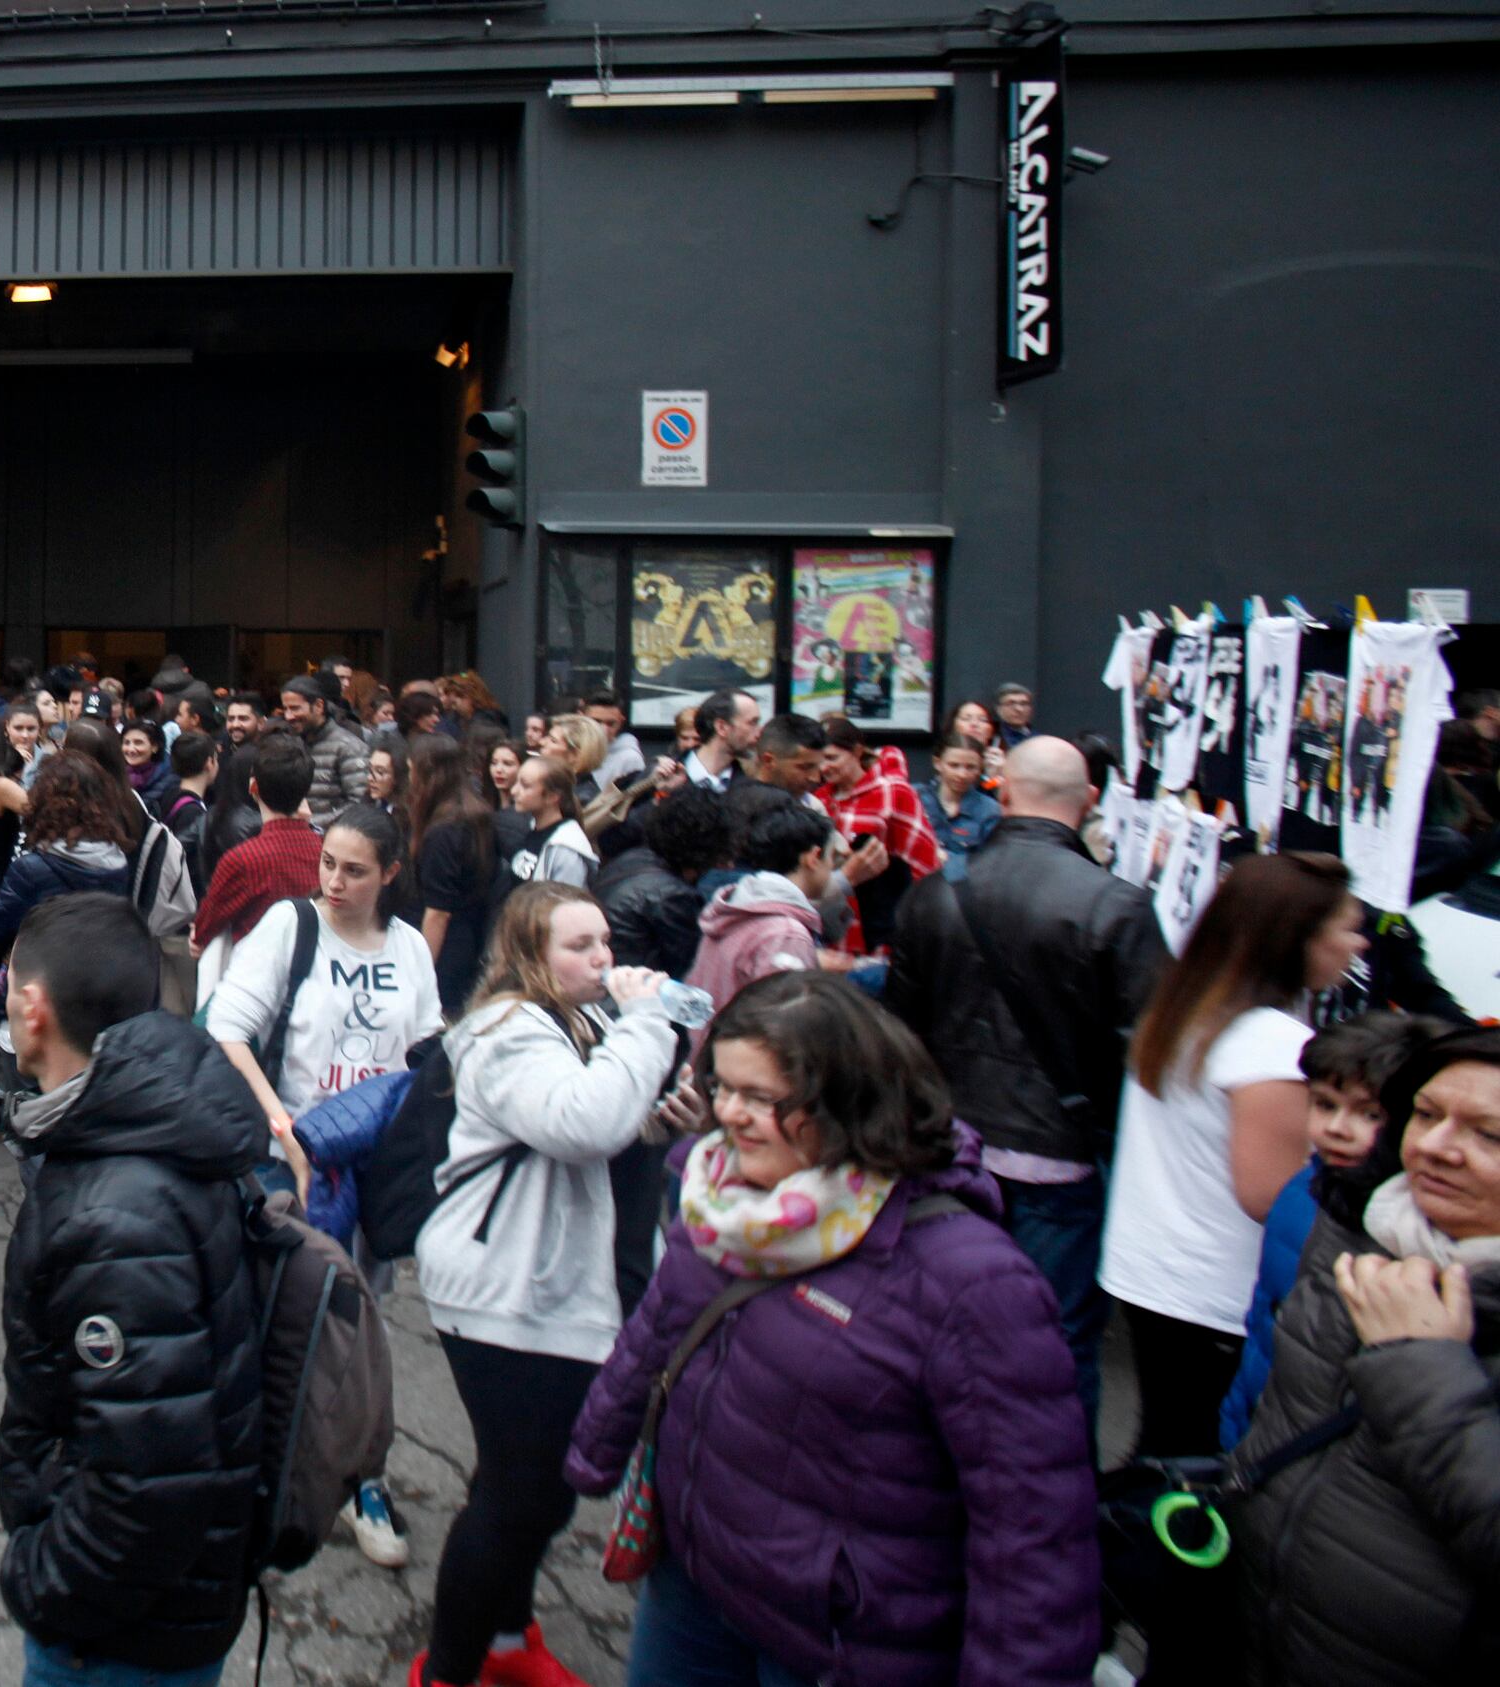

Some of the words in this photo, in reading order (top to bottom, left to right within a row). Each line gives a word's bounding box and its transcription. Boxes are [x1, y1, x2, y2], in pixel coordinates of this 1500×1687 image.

[1017, 80, 1058, 362] ALCATRAZ
[330, 959, 399, 991] ME
[344, 991, 388, 1031] &
